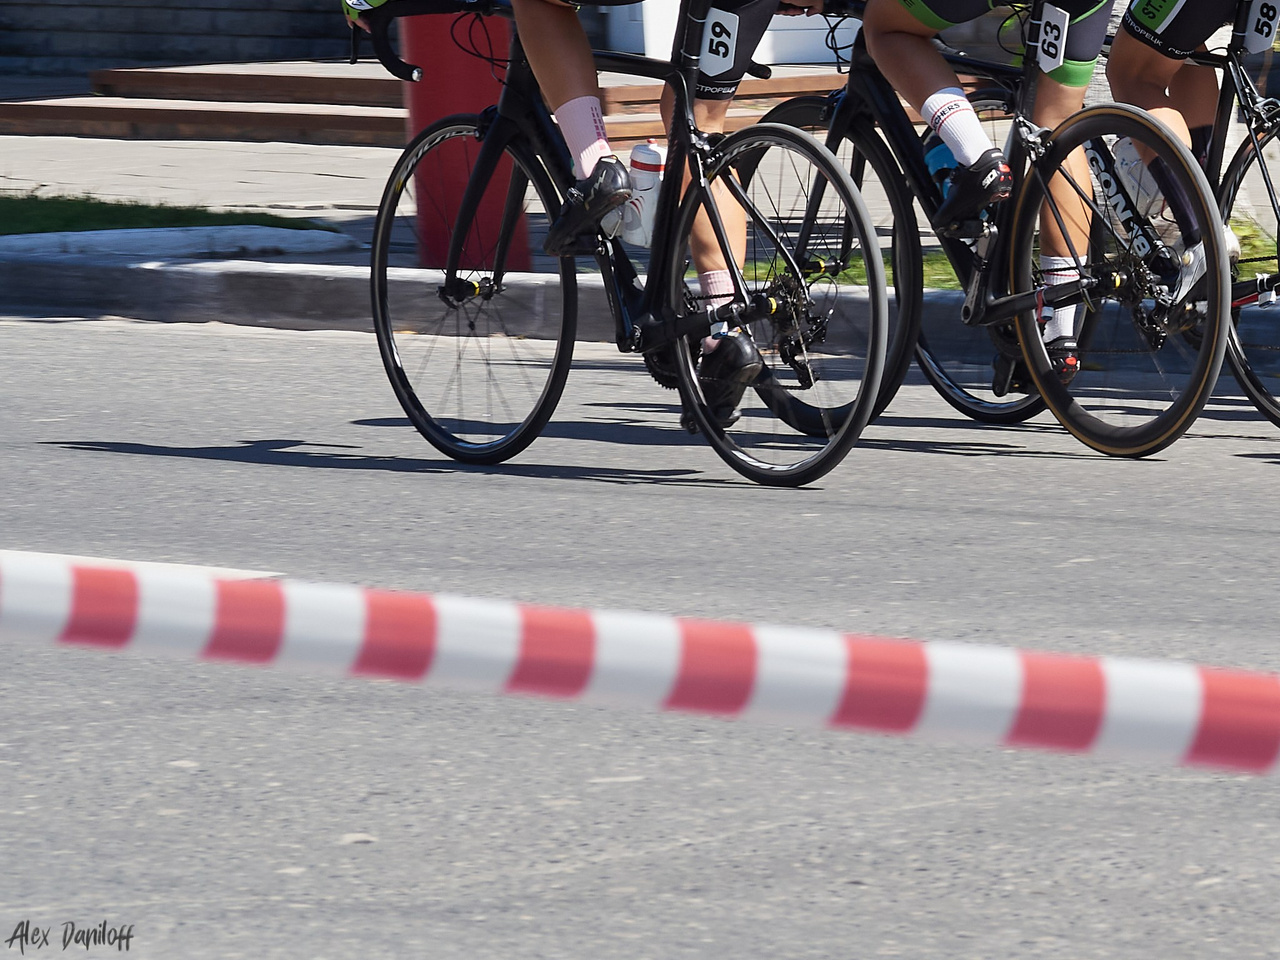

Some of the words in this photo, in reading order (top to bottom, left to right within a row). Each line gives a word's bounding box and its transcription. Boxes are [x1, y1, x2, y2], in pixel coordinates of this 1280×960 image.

[1254, 2, 1277, 38] 58
[708, 21, 732, 58] 59
[1041, 20, 1061, 59] 63
